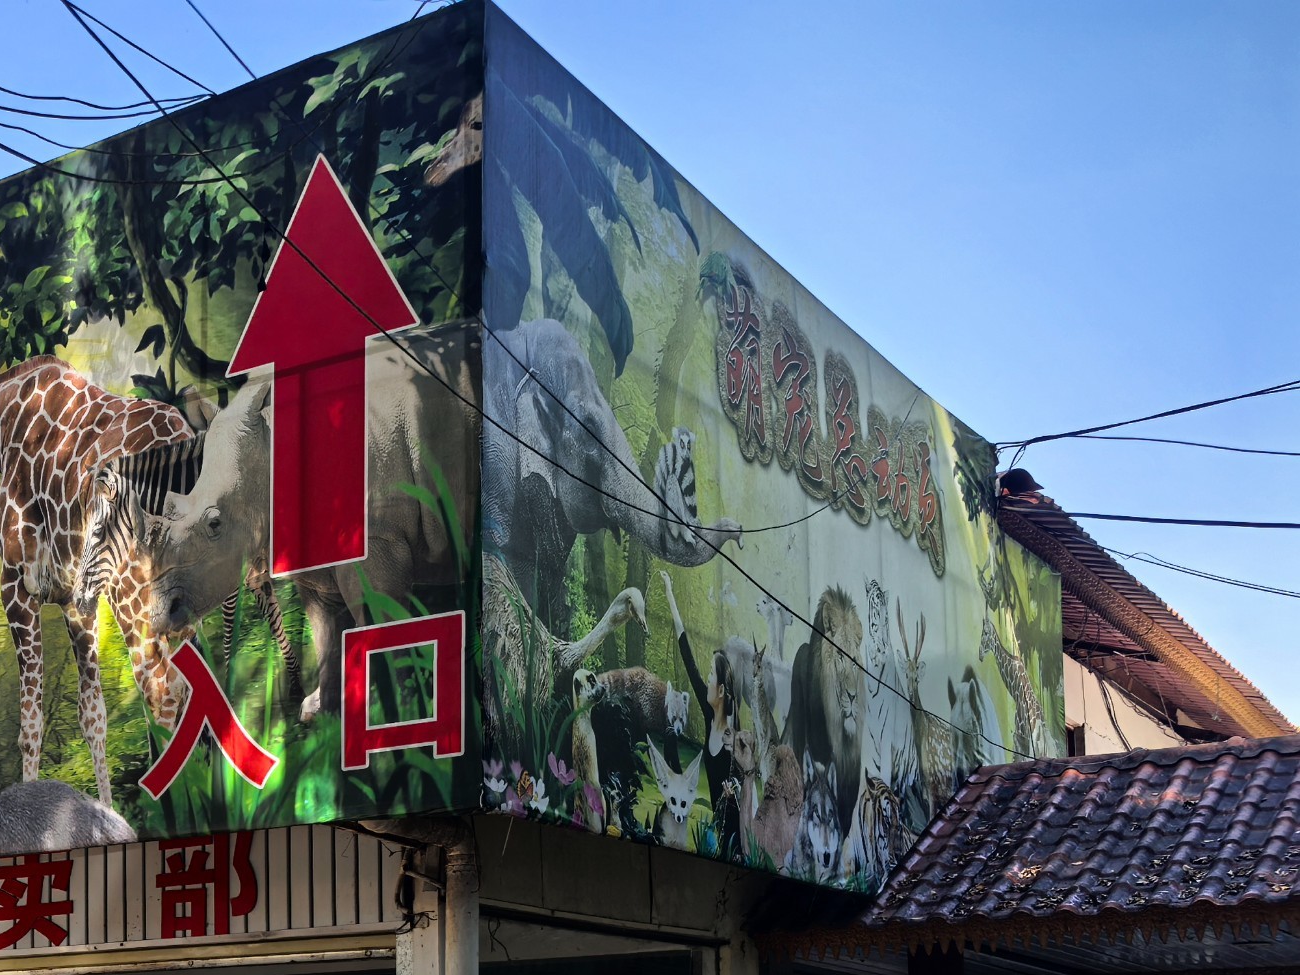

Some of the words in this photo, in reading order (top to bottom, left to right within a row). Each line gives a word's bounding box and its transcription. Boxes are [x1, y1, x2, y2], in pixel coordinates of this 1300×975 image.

[725, 279, 939, 560] 萌宠总动员
[140, 608, 468, 802] 入口
